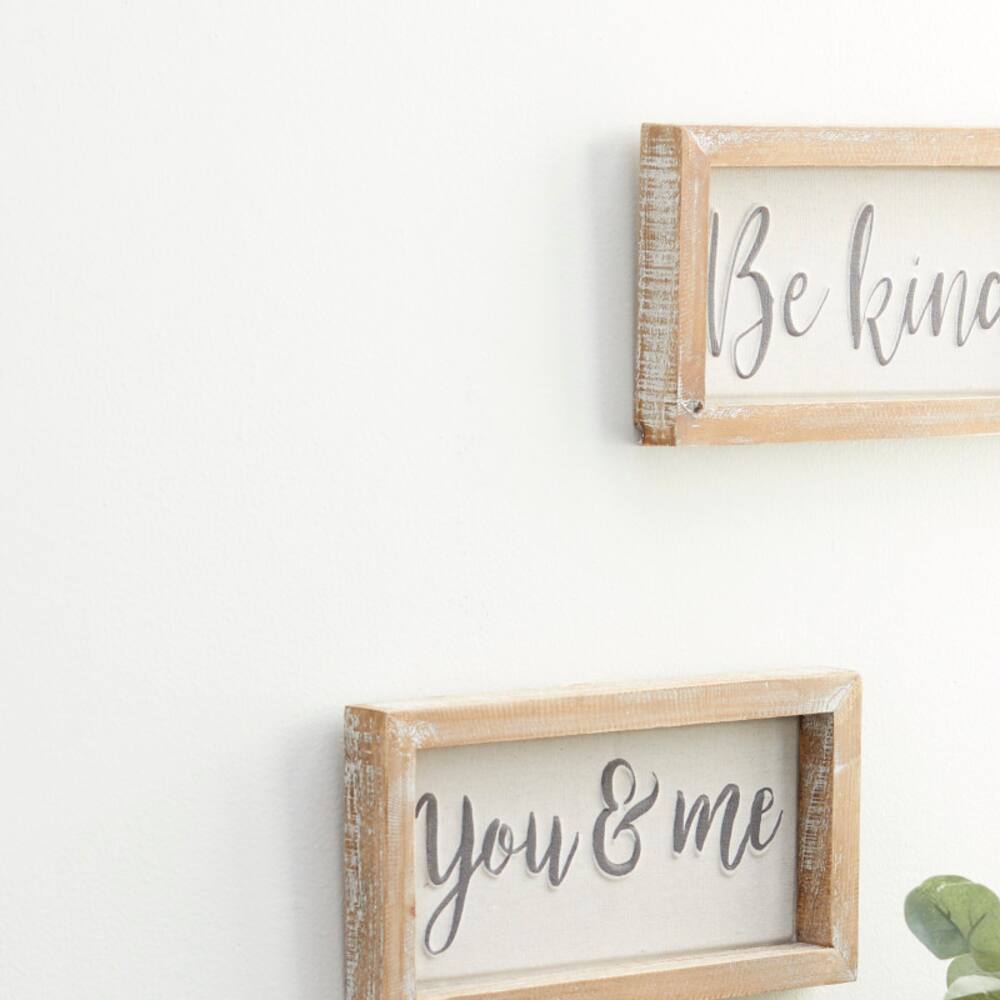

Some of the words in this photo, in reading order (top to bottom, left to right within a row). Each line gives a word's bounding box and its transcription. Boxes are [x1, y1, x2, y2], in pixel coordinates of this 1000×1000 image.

[708, 205, 830, 379] Be
[592, 757, 660, 877] &
[673, 782, 784, 872] me
